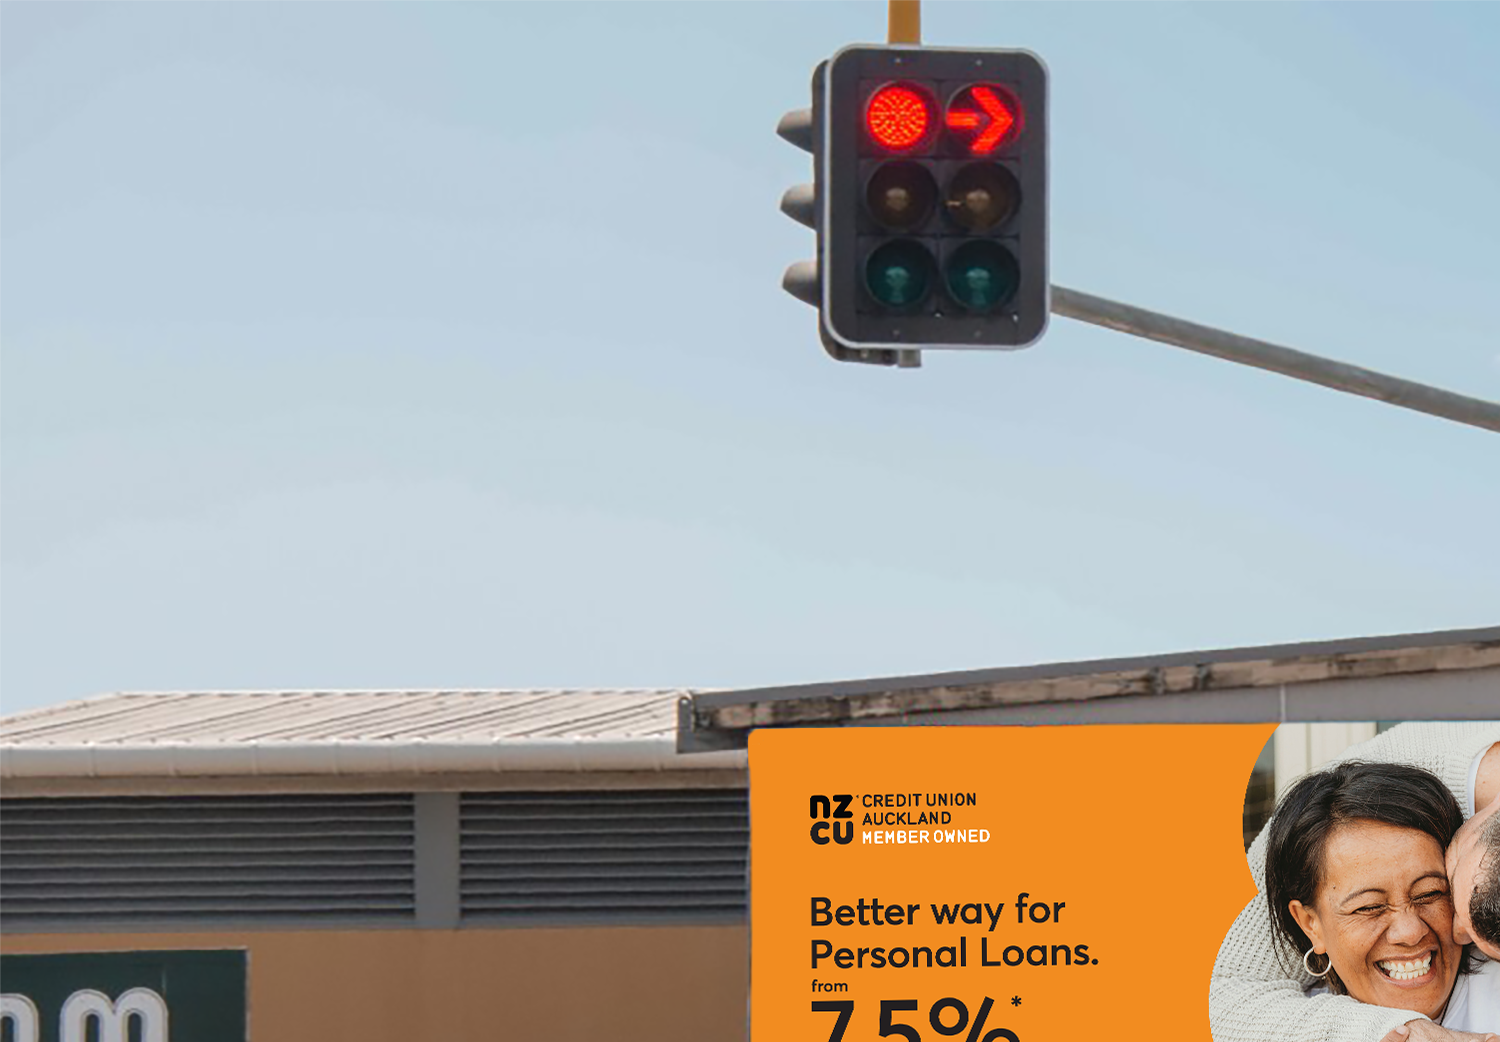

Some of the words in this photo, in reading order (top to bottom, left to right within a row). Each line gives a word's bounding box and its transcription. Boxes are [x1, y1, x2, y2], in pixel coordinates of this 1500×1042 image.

[862, 793, 923, 808] CREDIT
[926, 792, 977, 807] UNION
[862, 811, 952, 826] AUCKLAND
[862, 829, 930, 845] MEMBER
[933, 828, 991, 844] OWNED
[811, 896, 920, 927] Better
[930, 902, 1005, 932] way
[1014, 892, 1066, 924] for
[811, 936, 967, 969] Personal
[981, 936, 1100, 967] Loans.
[811, 978, 849, 993] from
